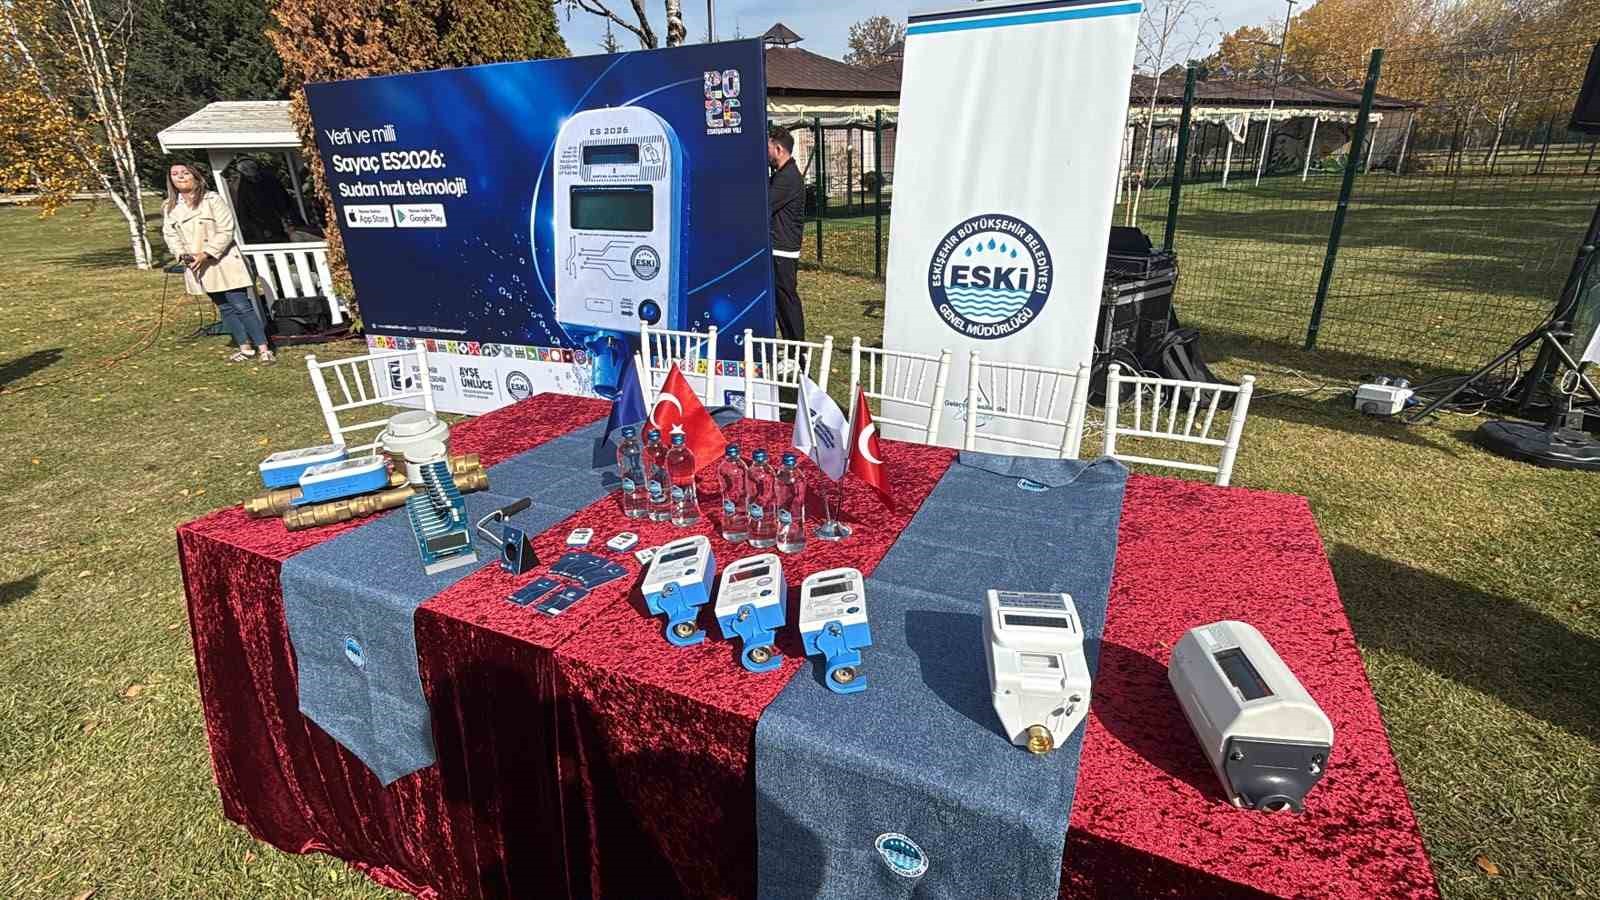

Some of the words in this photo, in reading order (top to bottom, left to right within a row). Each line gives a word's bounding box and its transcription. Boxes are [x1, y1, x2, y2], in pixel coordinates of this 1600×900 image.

[325, 128, 352, 145] Yerli
[352, 129, 371, 144] ve
[371, 124, 397, 143] milli
[589, 128, 601, 136] ES
[604, 126, 629, 135] 2026
[332, 154, 380, 176] Sayaç
[381, 149, 447, 171] ES2026:
[338, 181, 380, 197] Sudan
[380, 180, 405, 197] hızlı
[406, 177, 468, 198] teknoloji!
[359, 215, 372, 224] App
[372, 214, 389, 223] Store
[409, 214, 430, 224] Google
[430, 214, 443, 223] Play
[939, 303, 966, 331] GENEL
[966, 306, 1034, 337] MÜDÜRLÜĞÜ
